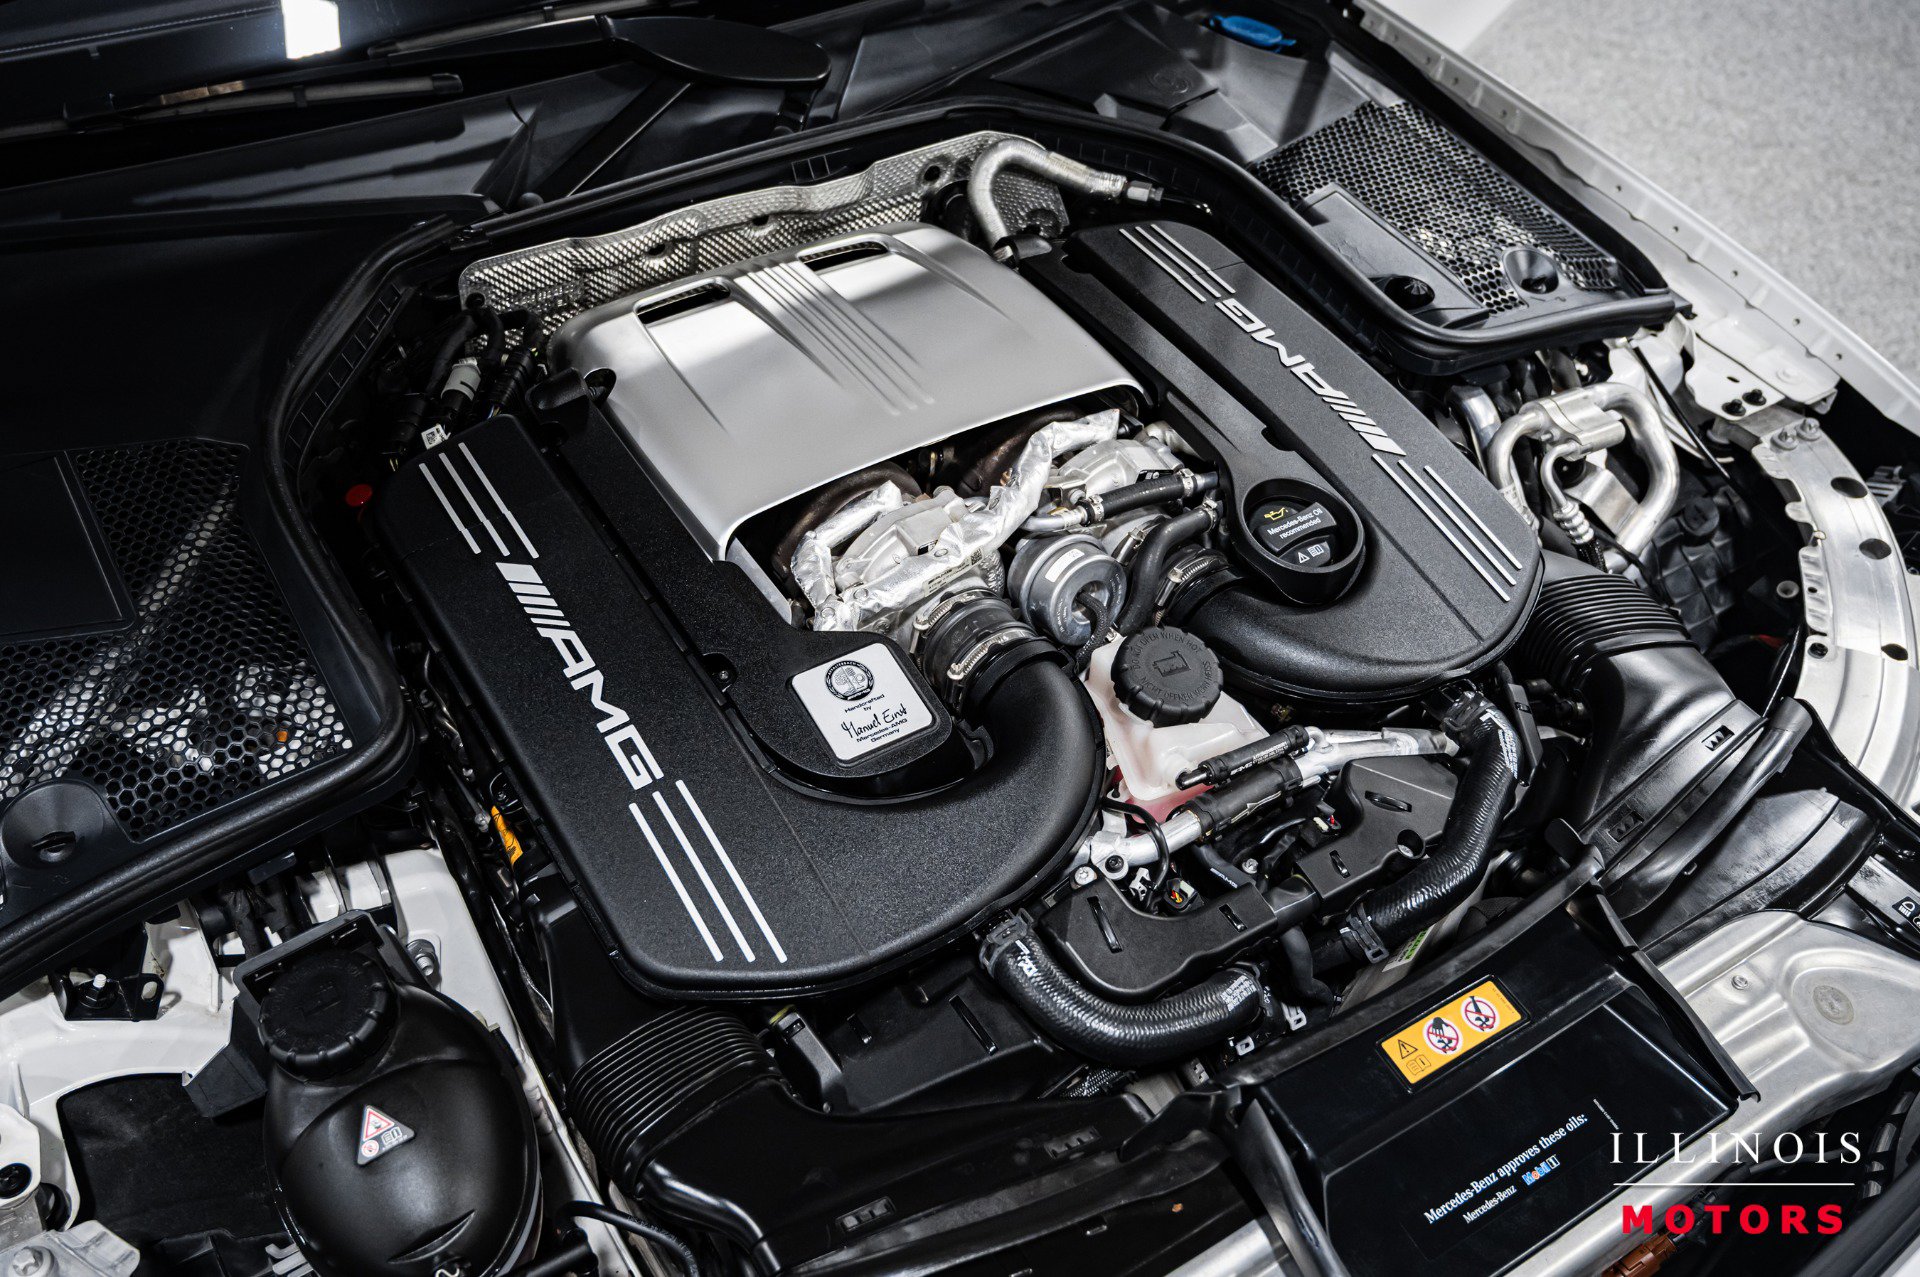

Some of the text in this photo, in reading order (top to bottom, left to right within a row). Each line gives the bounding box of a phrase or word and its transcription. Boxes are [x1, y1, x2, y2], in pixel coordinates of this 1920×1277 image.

[1267, 507, 1323, 536] Mercedes-Benz Oil
[1279, 517, 1322, 540] recommended
[1131, 659, 1141, 670] DO
[1141, 633, 1160, 646] OPEN
[1160, 631, 1185, 644] WHEN
[1186, 641, 1202, 654] HOT
[1140, 676, 1164, 694] NICHT
[535, 626, 665, 791] AMG
[844, 694, 885, 713] Handcrafted
[841, 713, 882, 739] Manuel
[856, 718, 908, 743] Mercedes-AMG
[870, 728, 900, 743] Germany
[1423, 1171, 1499, 1225] Mercedes-Benz
[1497, 1144, 1541, 1178] approves
[1538, 1126, 1567, 1150] these
[1565, 1114, 1588, 1132] oils:
[1462, 1184, 1518, 1225] Mercedes-Benz
[1521, 1160, 1551, 1186] Mobil
